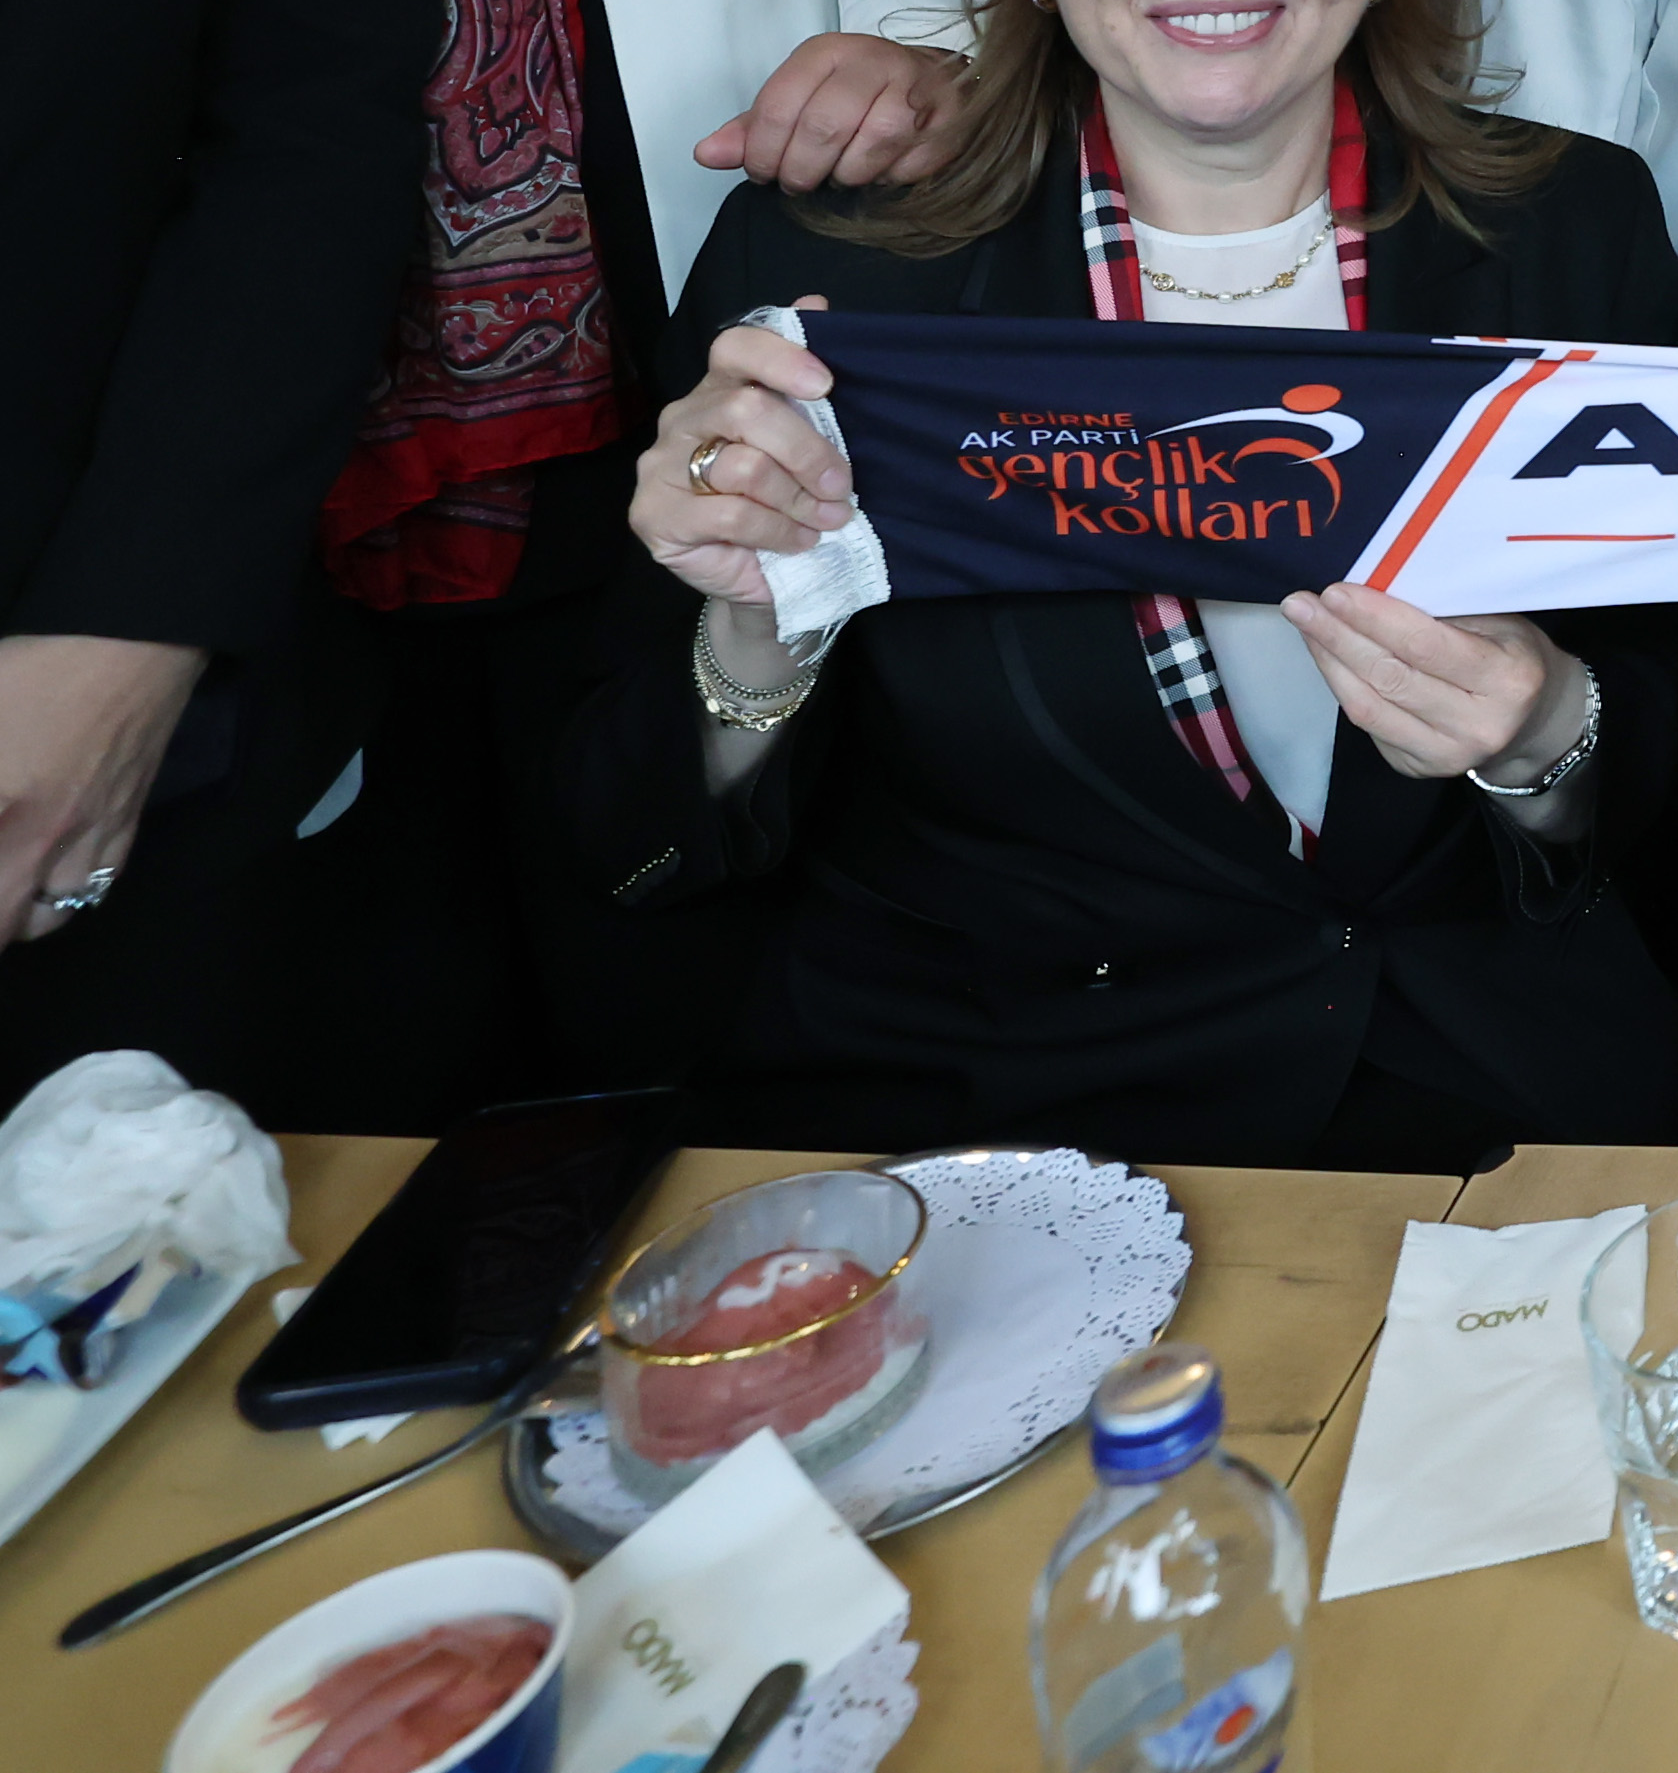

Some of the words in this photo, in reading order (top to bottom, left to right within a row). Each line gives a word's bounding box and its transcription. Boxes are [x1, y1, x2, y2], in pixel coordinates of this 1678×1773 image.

[960, 430, 1016, 450] AK
[1030, 428, 1140, 446] PARTİ
[997, 411, 1135, 428] EDİRNE
[957, 435, 1236, 501] gençlik
[1047, 488, 1312, 541] kolları
[1456, 1298, 1550, 1332] MADO
[622, 1618, 697, 1698] MADO
